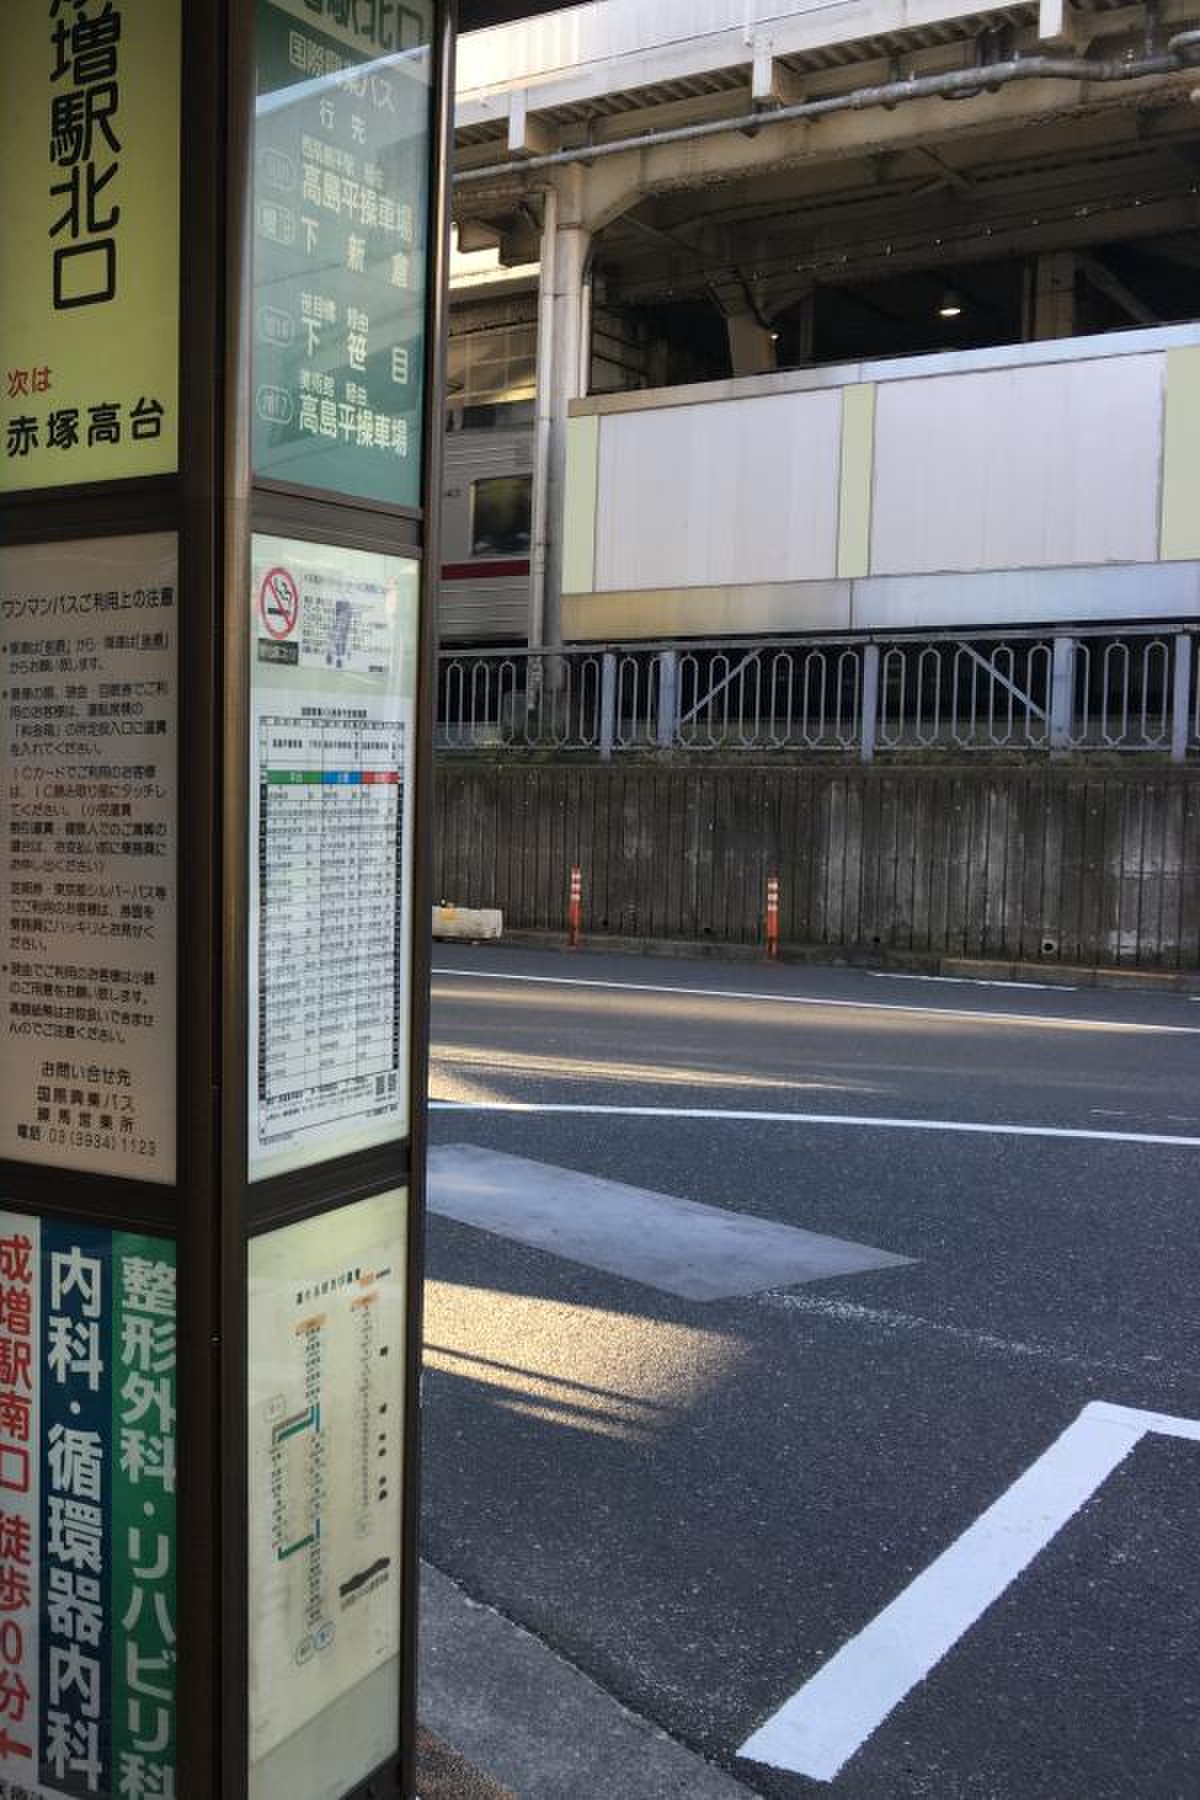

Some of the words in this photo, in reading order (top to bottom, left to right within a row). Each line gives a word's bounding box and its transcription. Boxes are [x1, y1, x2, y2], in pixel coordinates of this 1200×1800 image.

[48, 0, 122, 310] 増駅北口
[7, 366, 53, 398] 次は
[6, 397, 165, 458] 赤塚高台
[40, 1059, 131, 1087] お問い合せ先
[47, 1245, 105, 1794] 内科・循環器内科
